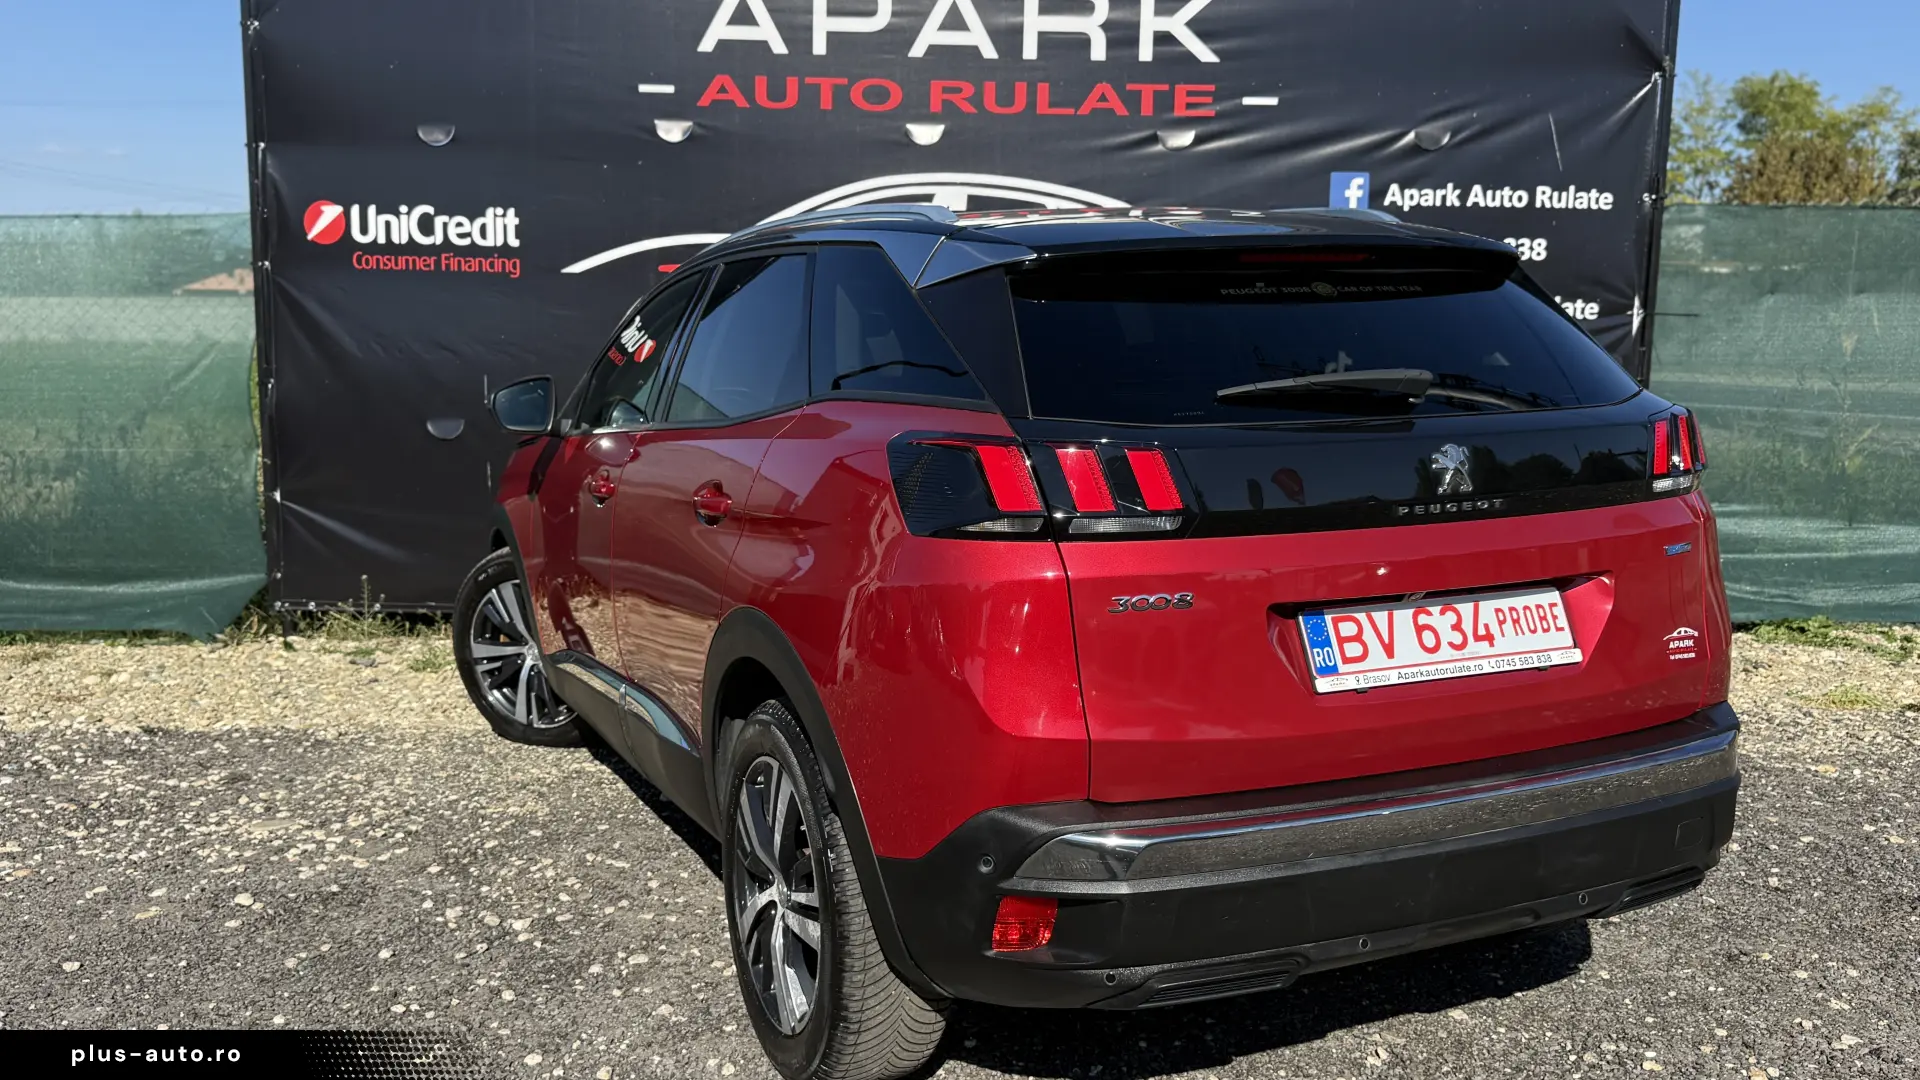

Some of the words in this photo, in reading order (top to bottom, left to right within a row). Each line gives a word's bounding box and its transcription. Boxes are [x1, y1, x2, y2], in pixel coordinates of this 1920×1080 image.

[697, 0, 1221, 62] APARK
[696, 74, 903, 112] AUTO
[930, 80, 1216, 117] RULATE
[1383, 182, 1462, 212] Apark
[1466, 184, 1529, 208] Auto
[1535, 184, 1614, 210] Rulate
[350, 203, 520, 248] UniCredit
[352, 251, 437, 271] Consumer
[441, 253, 520, 278] Financing
[1220, 287, 1278, 295] PEUGEOT
[1398, 499, 1504, 516] PEUGEOT
[1107, 592, 1194, 613] 3008
[1331, 609, 1395, 665] BV
[1411, 601, 1496, 655] 634
[1493, 602, 1565, 638] PROBE
[1668, 639, 1695, 649] APARK
[1313, 646, 1335, 668] RO
[1397, 663, 1484, 681] Aparkautorulate.ro
[1495, 658, 1517, 669] 0745
[1519, 655, 1535, 667] 583
[1536, 653, 1553, 664] 838
